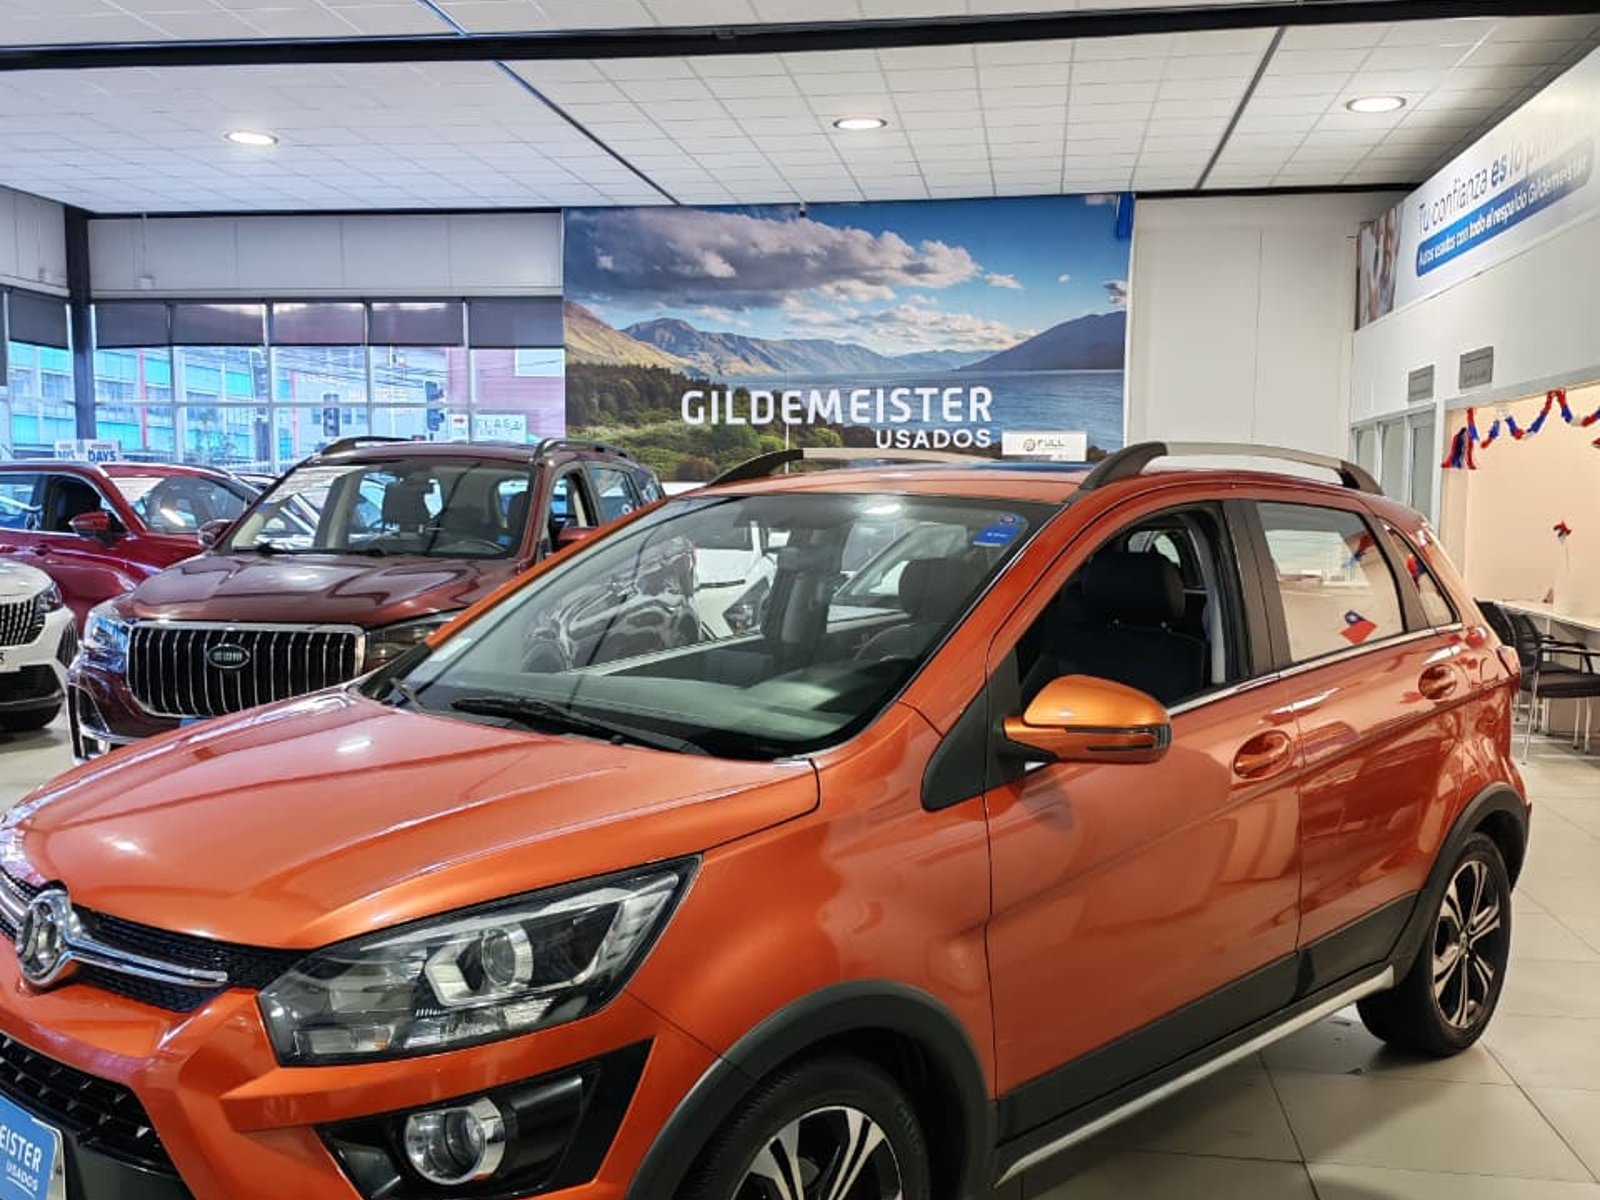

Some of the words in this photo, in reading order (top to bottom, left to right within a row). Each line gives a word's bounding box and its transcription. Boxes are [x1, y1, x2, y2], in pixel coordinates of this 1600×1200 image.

[1418, 202, 1431, 235] Tu
[1431, 168, 1488, 226] confianza
[1491, 153, 1508, 188] es
[681, 386, 992, 425] GILDEMEISTER
[876, 428, 991, 449] USADOS
[88, 450, 116, 462] DAYS
[6, 1160, 39, 1191] USADOS
